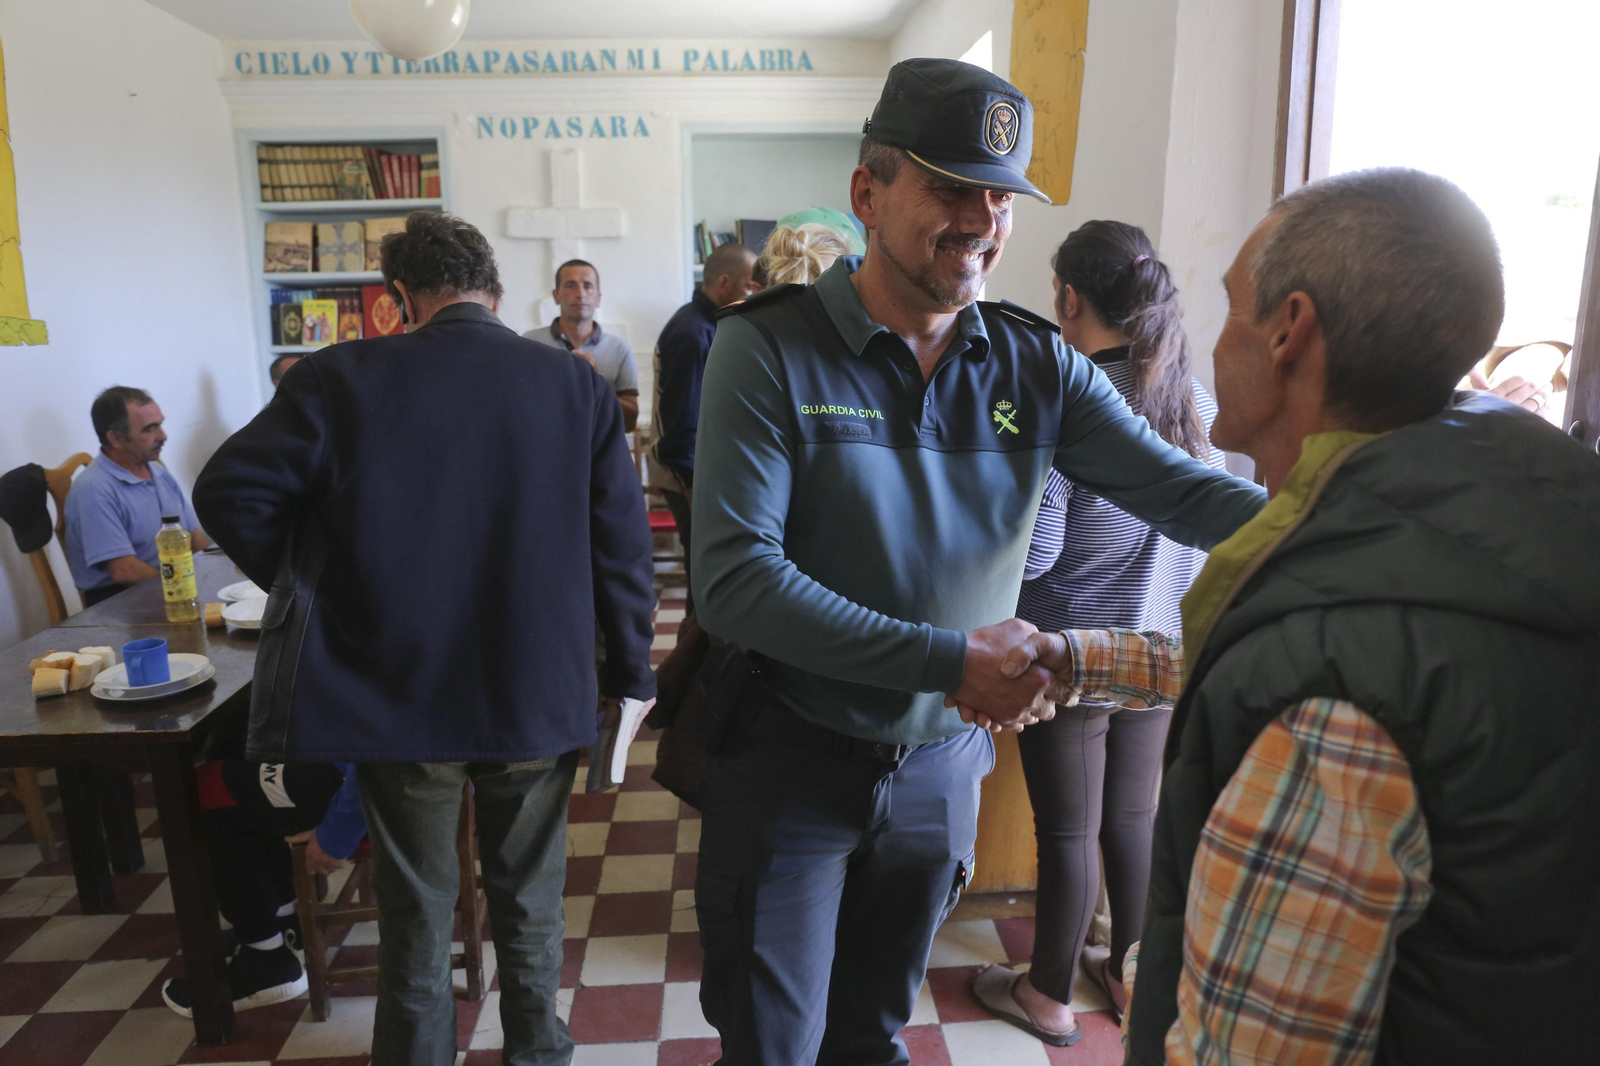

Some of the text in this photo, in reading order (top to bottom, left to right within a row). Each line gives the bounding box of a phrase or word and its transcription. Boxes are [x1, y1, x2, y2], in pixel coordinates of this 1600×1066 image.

[235, 51, 330, 75] CIELO
[627, 48, 661, 71] MI
[683, 48, 814, 72] PALABRA
[800, 404, 885, 420] GUARDIA CIVIL
